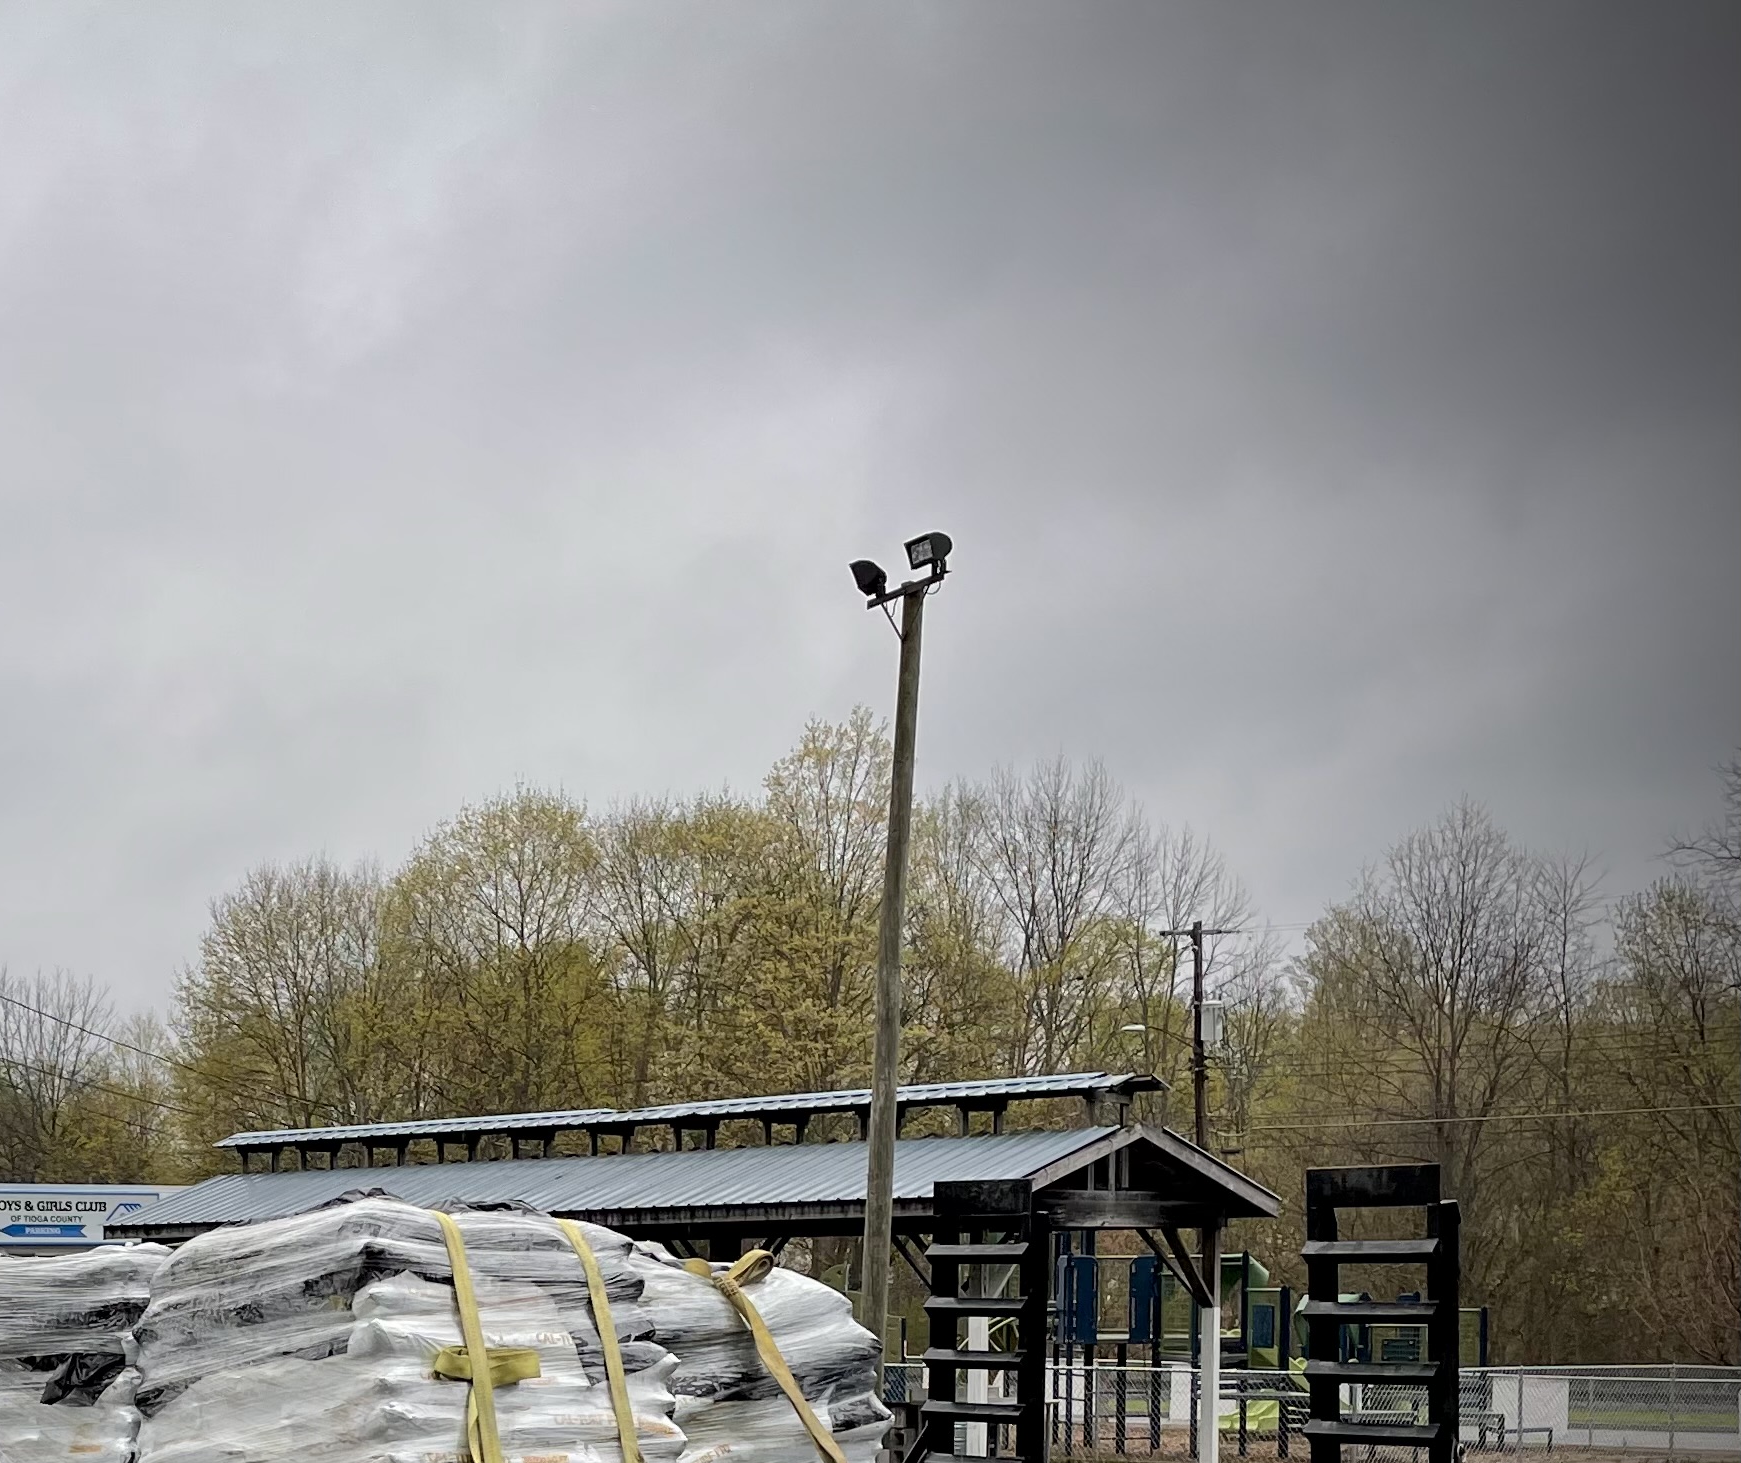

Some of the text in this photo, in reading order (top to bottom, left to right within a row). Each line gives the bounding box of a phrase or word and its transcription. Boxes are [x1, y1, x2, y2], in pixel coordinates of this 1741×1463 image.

[24, 1200, 34, 1212] &
[37, 1200, 73, 1212] GIRLS
[75, 1201, 107, 1213] CLUB
[10, 1215, 83, 1224] OF TIOGA COUNTY
